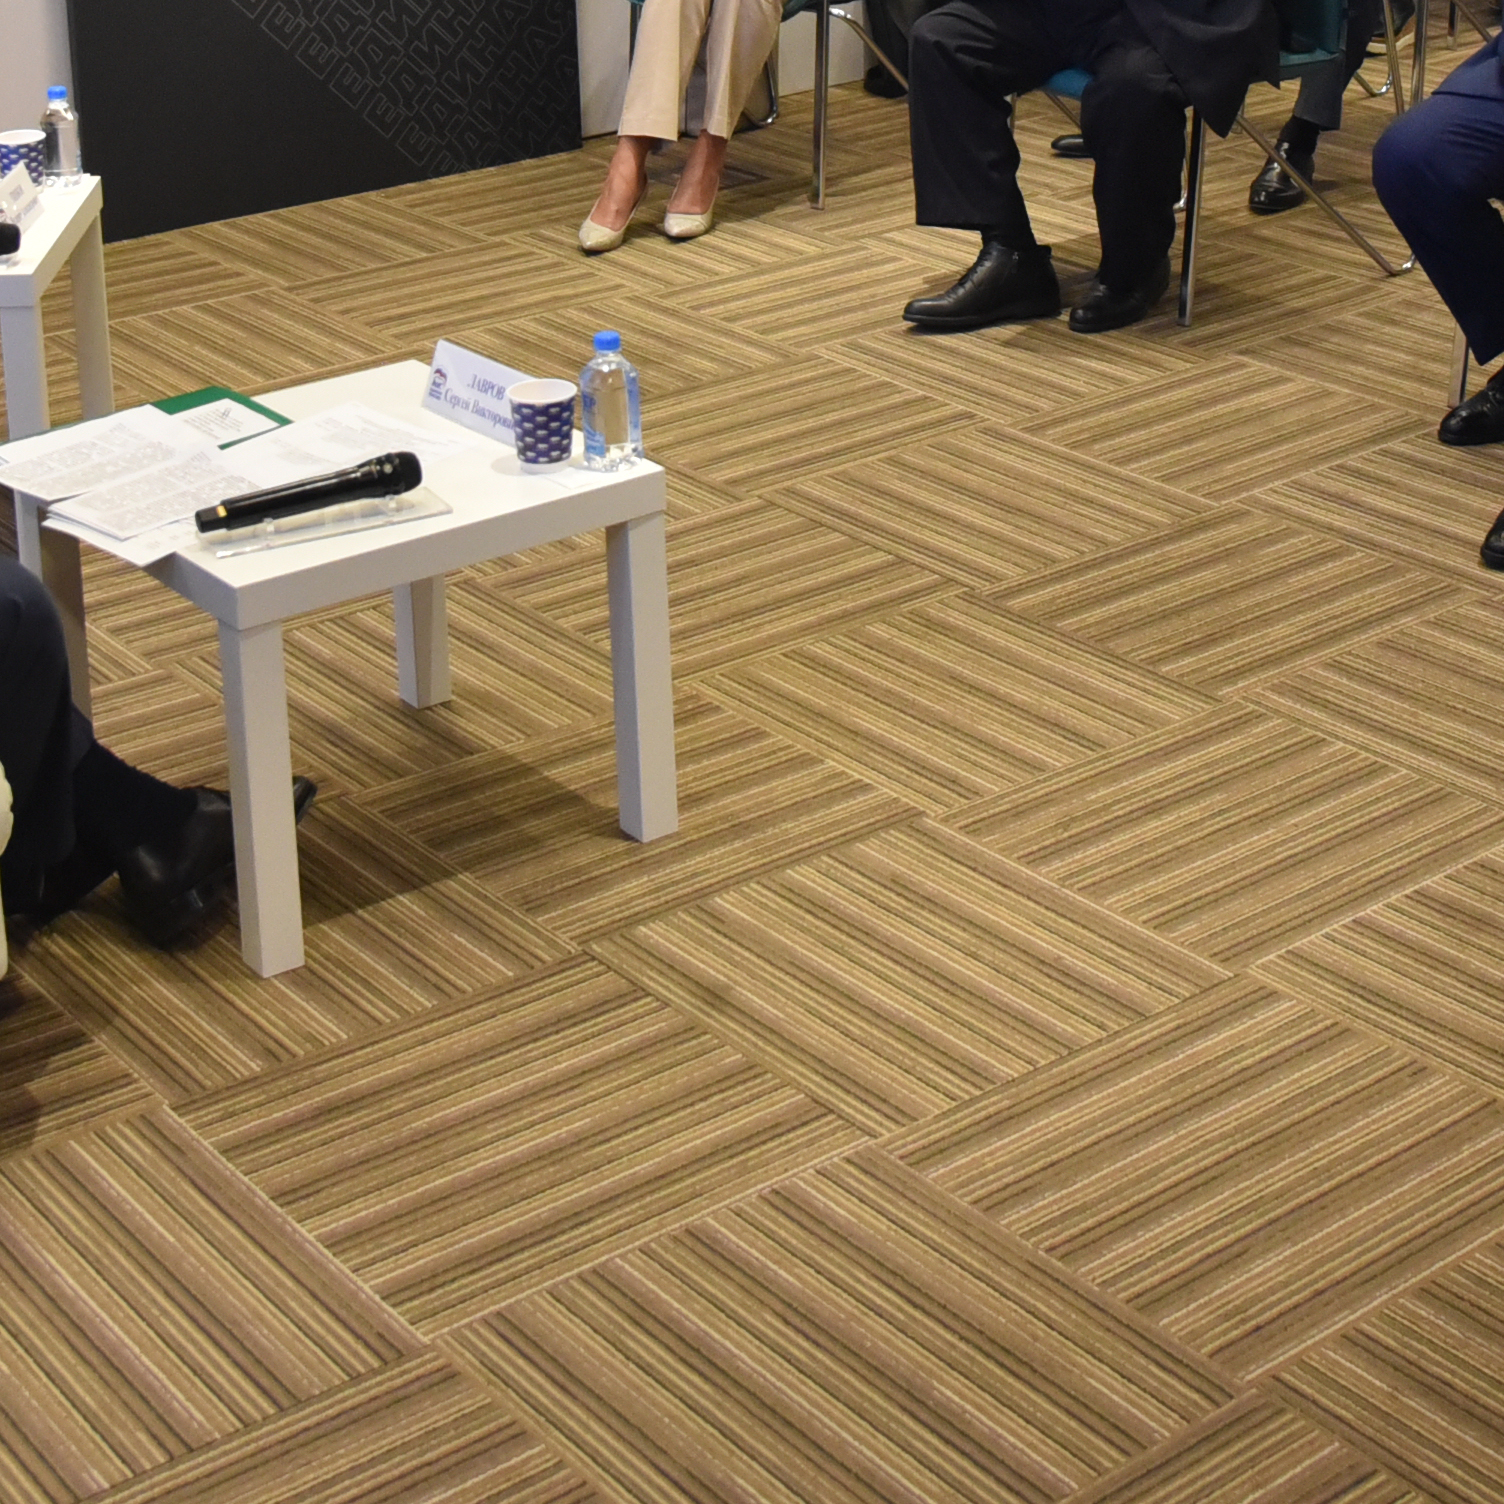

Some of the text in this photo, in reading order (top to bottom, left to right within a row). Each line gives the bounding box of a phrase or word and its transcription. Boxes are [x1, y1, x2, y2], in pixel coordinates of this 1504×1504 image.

[466, 373, 506, 401] ЛАВРОВ
[444, 388, 472, 410] Сергей
[471, 399, 515, 430] Викторови
